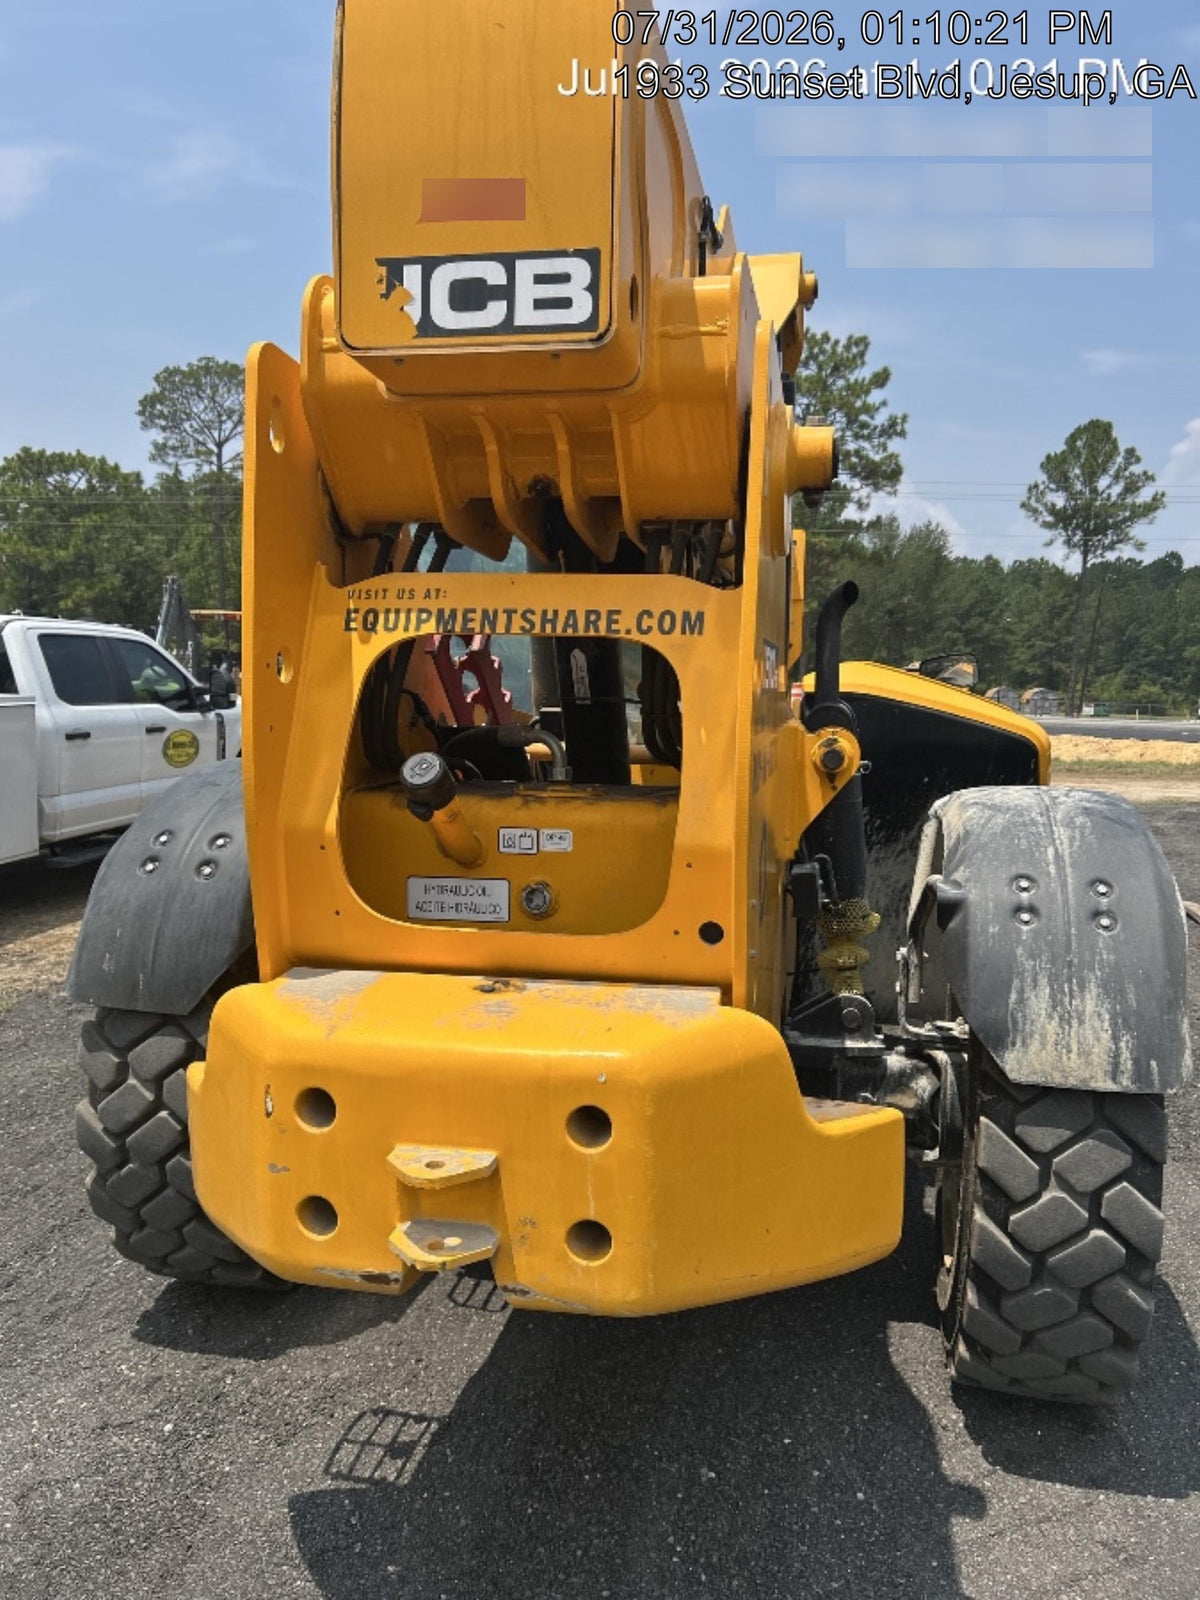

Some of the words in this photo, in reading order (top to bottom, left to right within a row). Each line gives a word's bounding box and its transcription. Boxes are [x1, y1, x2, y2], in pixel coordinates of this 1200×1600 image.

[347, 588, 388, 600] VISIT
[396, 588, 416, 600] US
[423, 588, 448, 600] AT:
[344, 607, 705, 636] EQUIPMENTSHARE.COM
